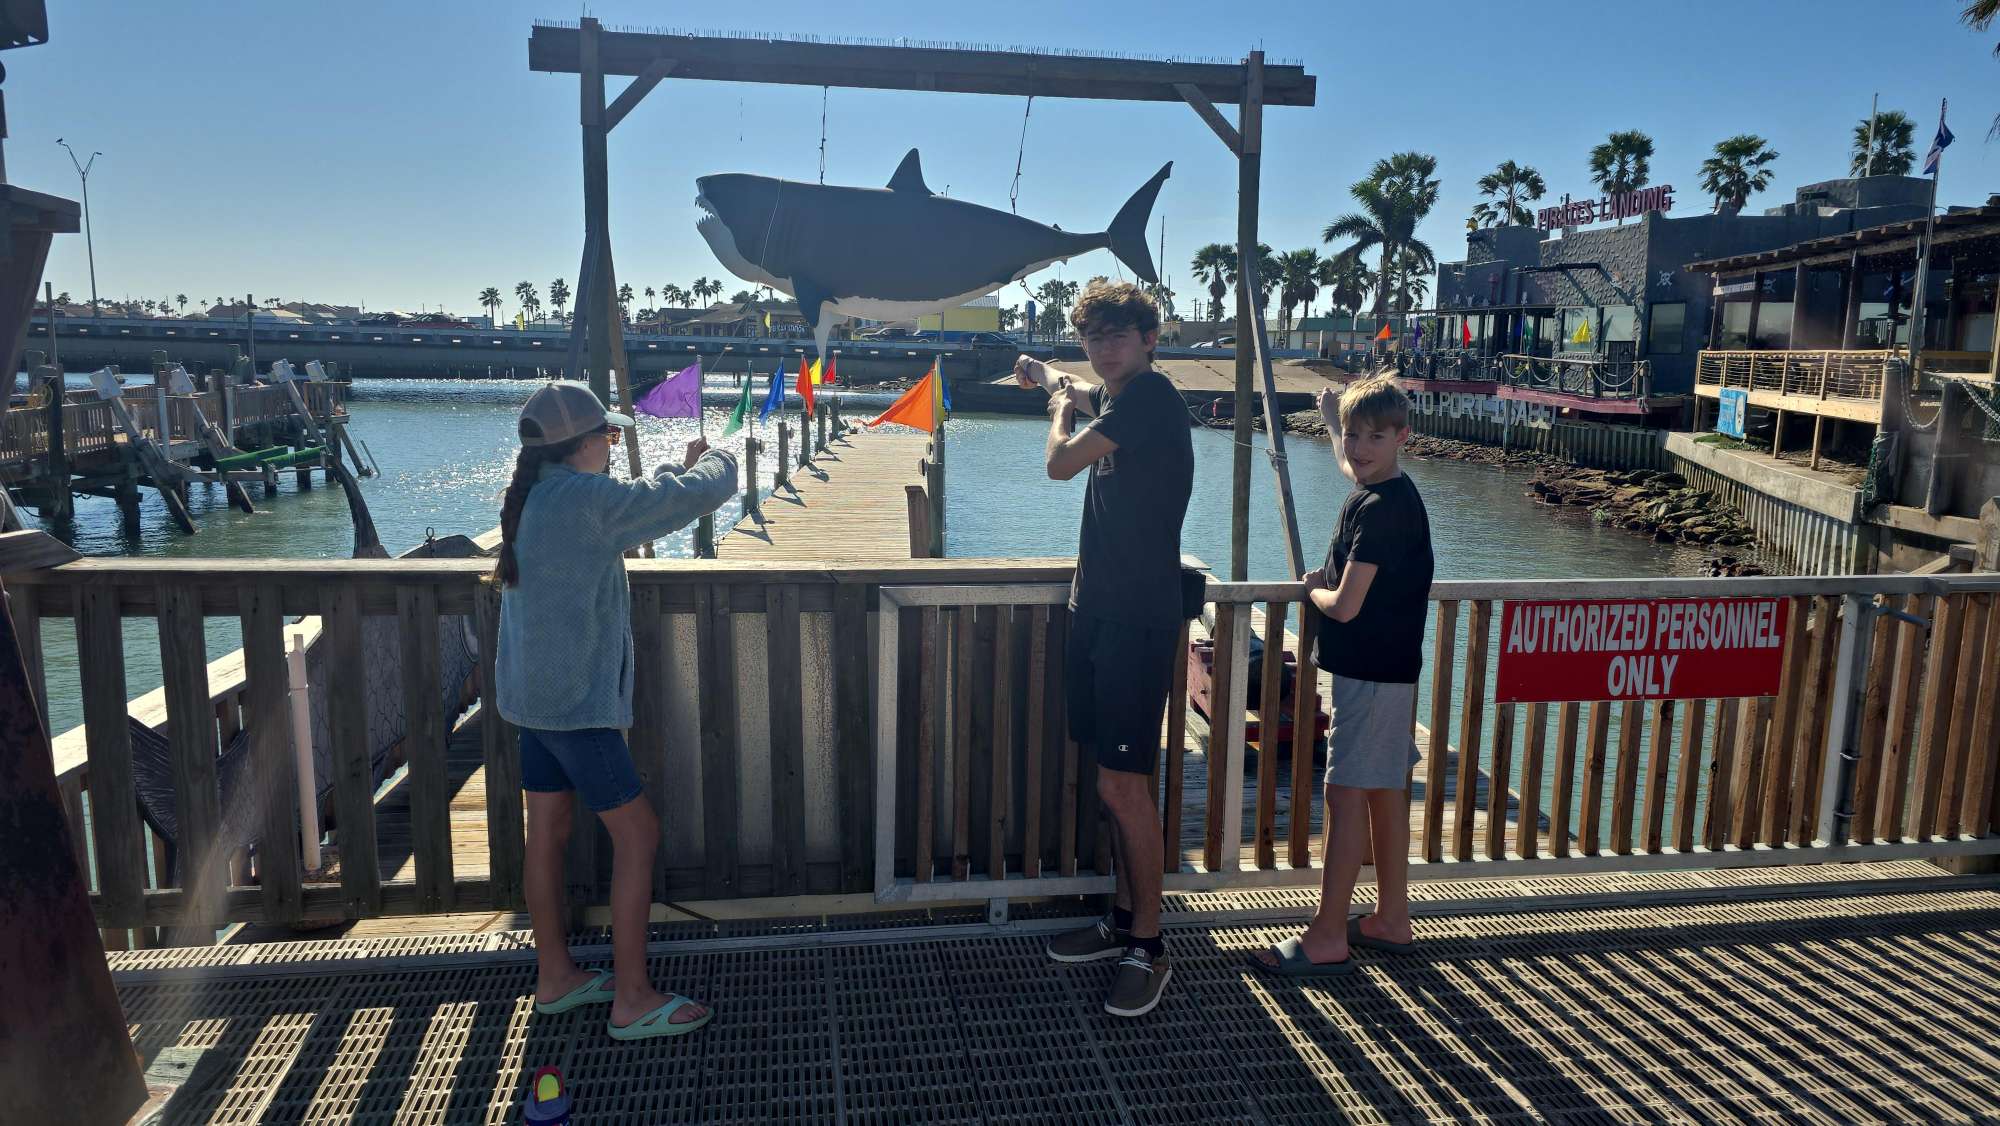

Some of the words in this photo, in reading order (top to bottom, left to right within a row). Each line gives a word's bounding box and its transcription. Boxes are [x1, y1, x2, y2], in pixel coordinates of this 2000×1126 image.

[1537, 199, 1595, 232] PIRATES
[1600, 184, 1673, 222] LANDING
[1413, 390, 1434, 416] TO
[1439, 391, 1486, 421] PORT
[1506, 604, 1650, 653] AUTHORIZED
[1653, 601, 1780, 650] PERSONNEL
[1607, 655, 1679, 697] ONLY
